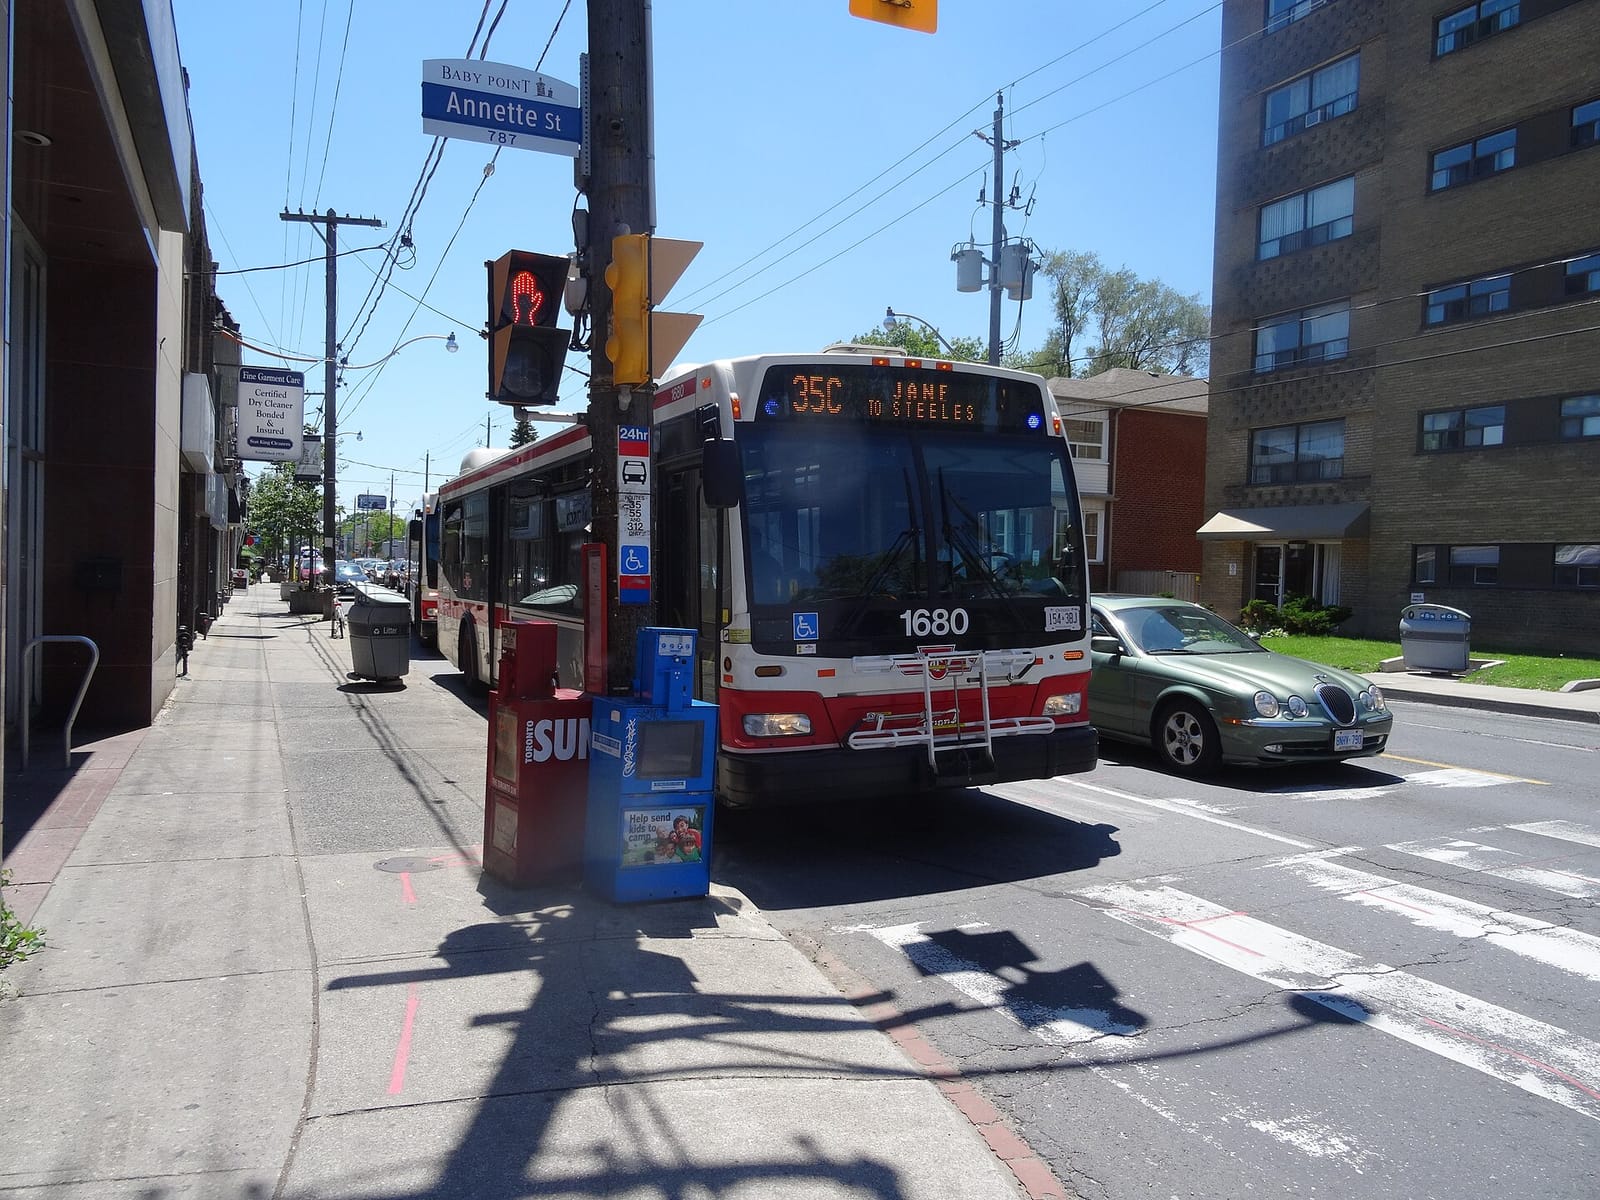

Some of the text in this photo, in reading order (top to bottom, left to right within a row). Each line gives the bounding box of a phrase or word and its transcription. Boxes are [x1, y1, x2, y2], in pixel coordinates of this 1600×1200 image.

[441, 65, 531, 93] BABY POINT
[446, 91, 561, 132] Annette St
[487, 130, 517, 145] 787
[243, 371, 301, 384] Fine Garment Care
[255, 389, 287, 399] Certified
[792, 375, 842, 414] 35C
[248, 398, 293, 409] Dry Cleaner
[256, 410, 285, 419] Bonded
[868, 399, 974, 421] TO STEELES
[266, 419, 274, 427] &
[256, 426, 285, 435] Insured
[620, 428, 648, 441] 24hr
[629, 501, 642, 509] 35
[629, 509, 642, 517] 55
[627, 522, 644, 531] 312
[900, 608, 969, 637] 1680
[525, 720, 534, 764] TORONTO
[629, 812, 671, 823] Help send
[628, 823, 657, 833] kids to
[628, 833, 652, 842] camp
